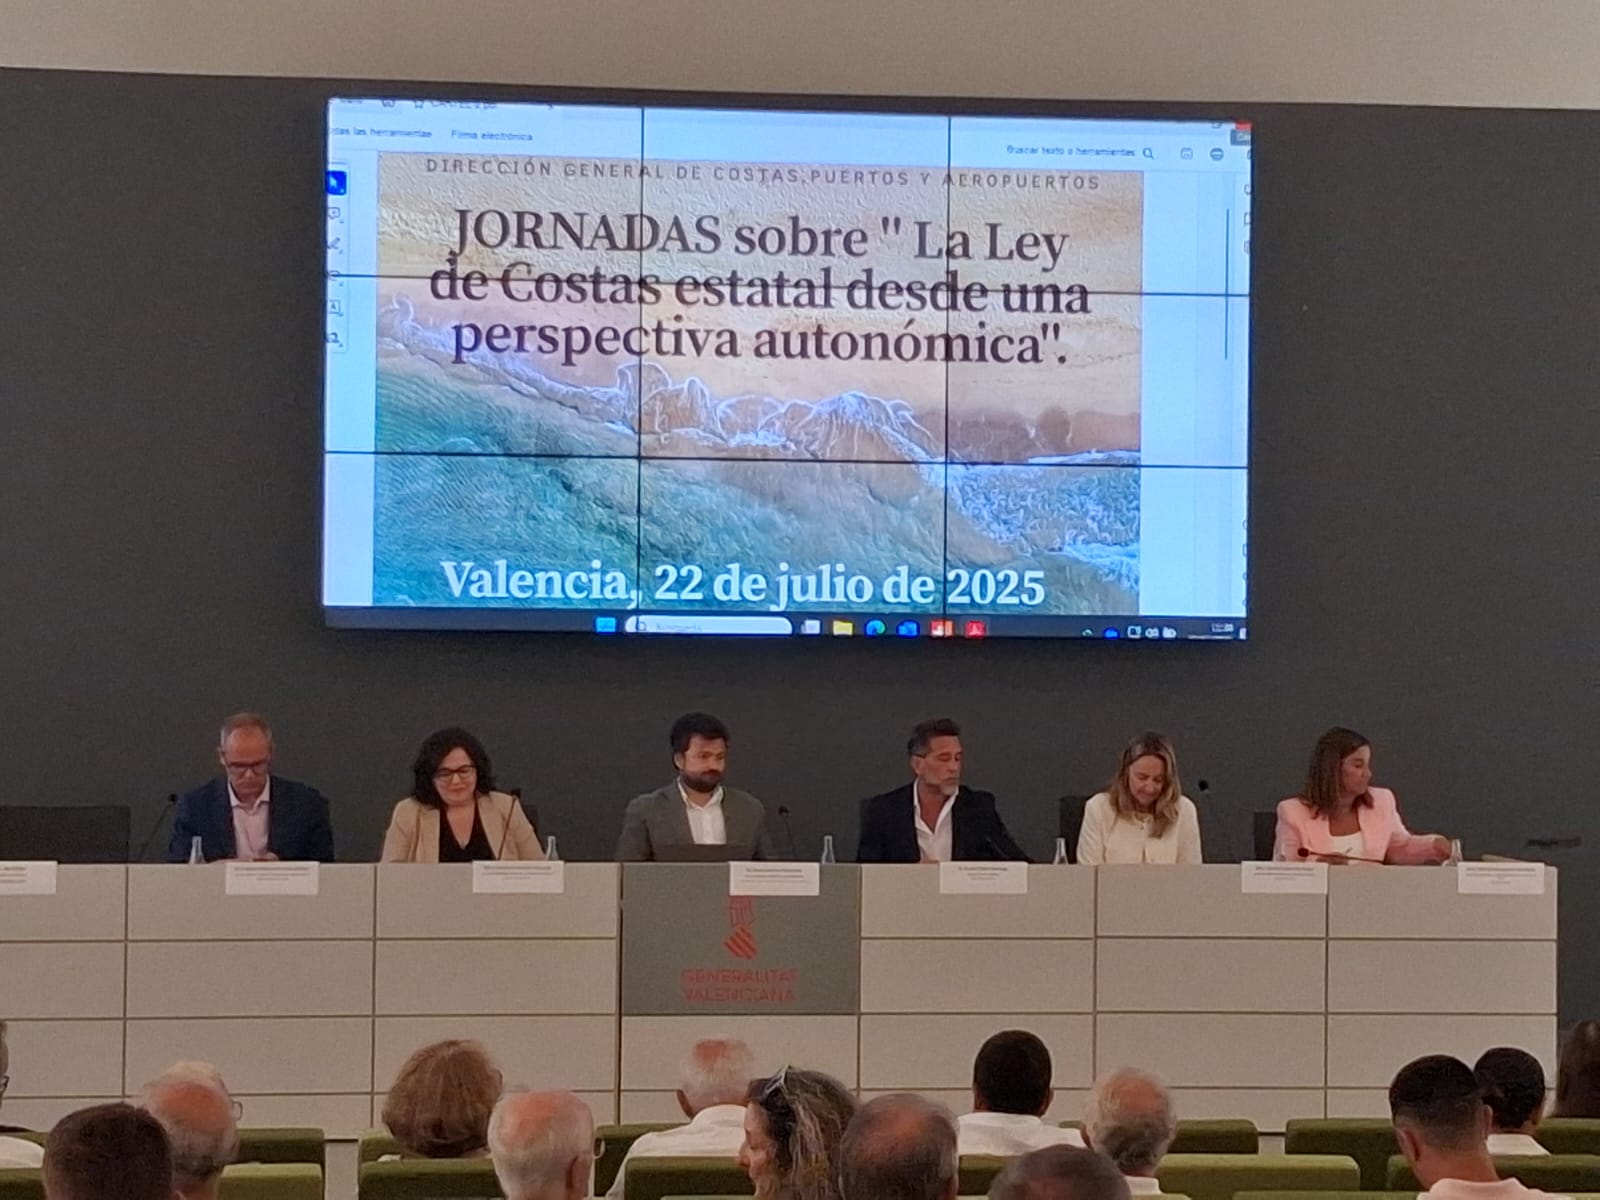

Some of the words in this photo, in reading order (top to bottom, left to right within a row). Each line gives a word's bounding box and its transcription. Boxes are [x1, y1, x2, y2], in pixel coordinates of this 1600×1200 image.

[370, 128, 432, 138] herramientas
[1006, 145, 1038, 155] Buscar
[427, 156, 552, 176] DIRECCIÓN
[564, 163, 665, 179] GENERAL
[676, 166, 701, 180] DE
[920, 173, 931, 184] Y
[942, 174, 1100, 190] AEROPUERTOS
[451, 209, 722, 256] JORNADAS
[733, 215, 868, 256] sobre
[914, 221, 972, 260] La
[984, 222, 1070, 272] Ley
[430, 258, 488, 300] de
[499, 260, 663, 305] Costas
[674, 266, 834, 308] estatal
[846, 268, 989, 312] desde
[1002, 279, 1092, 314] una
[452, 314, 742, 366] perspectiva
[754, 317, 1067, 364] autonómica".
[440, 559, 642, 609] Valencia,
[654, 564, 703, 600] 22
[713, 563, 768, 602] de
[770, 562, 874, 612] julio
[882, 566, 936, 604] de
[945, 568, 1046, 606] 2025
[681, 967, 798, 983] GENERALITAT
[683, 986, 797, 1002] VALENCIANA
